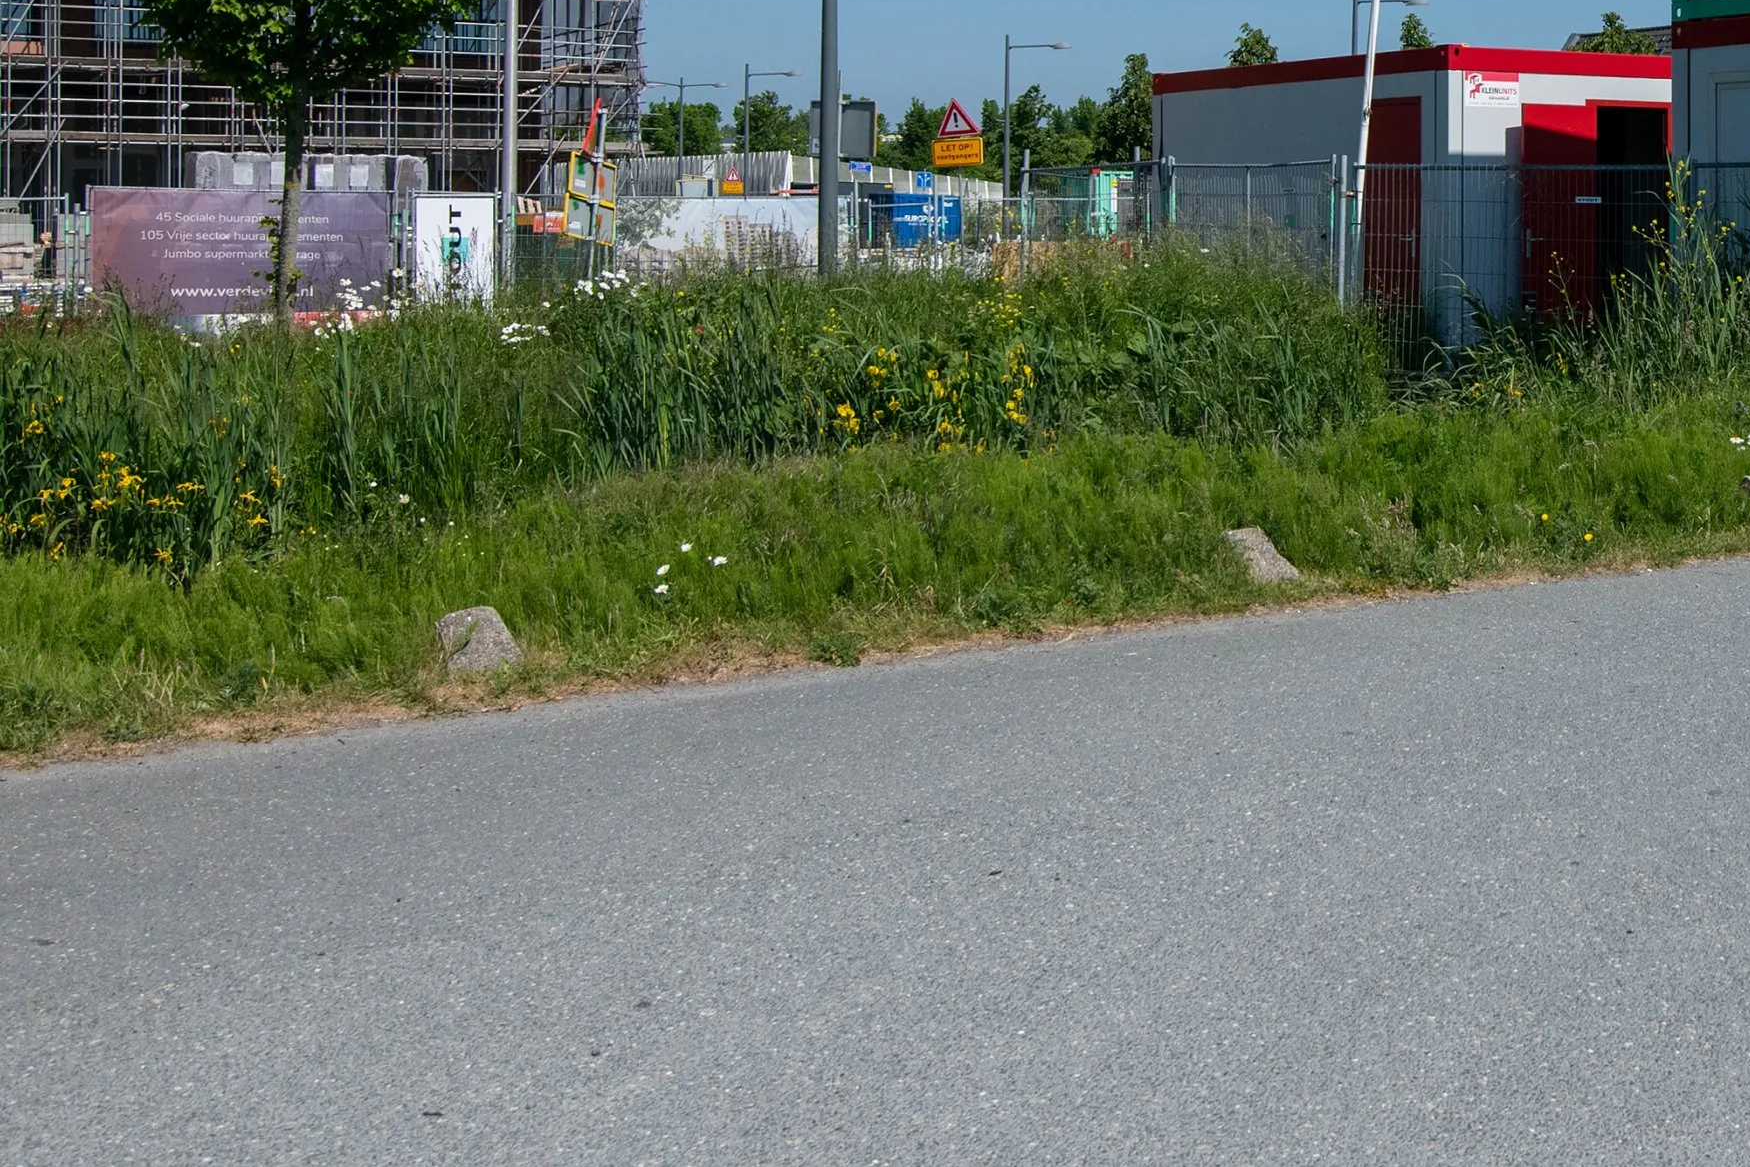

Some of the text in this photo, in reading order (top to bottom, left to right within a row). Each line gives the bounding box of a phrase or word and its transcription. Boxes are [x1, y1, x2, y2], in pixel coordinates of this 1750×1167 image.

[941, 144, 956, 152] LET
[155, 212, 172, 222] 45
[175, 212, 215, 223] Sociale
[140, 230, 164, 240] 105
[166, 230, 192, 243] Vrije
[195, 231, 230, 241] sector
[163, 248, 202, 259] Jumbo
[204, 248, 269, 262] supermarkt
